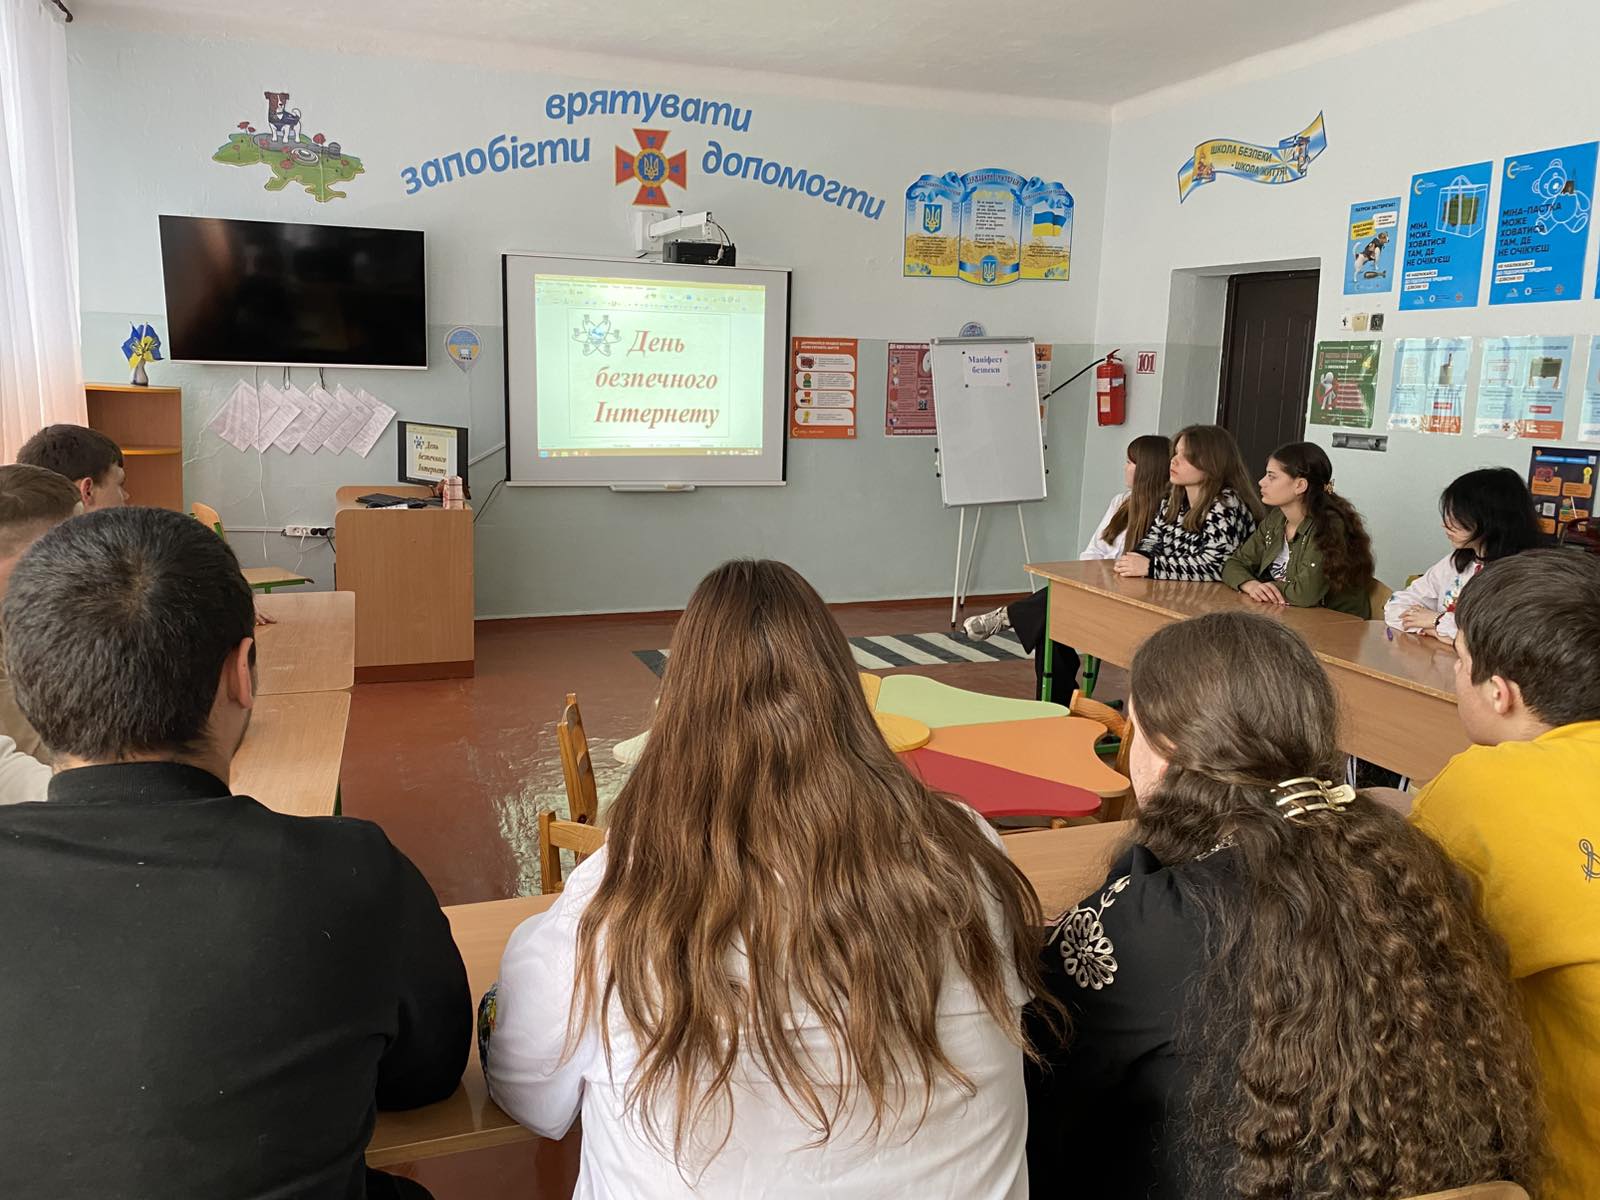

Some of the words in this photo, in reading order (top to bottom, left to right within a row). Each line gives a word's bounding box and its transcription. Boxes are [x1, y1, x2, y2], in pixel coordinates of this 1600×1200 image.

[545, 90, 753, 132] врятувати
[1210, 144, 1237, 155] ШКОЛА
[1238, 146, 1272, 163] БЕЗПЕКИ
[400, 135, 590, 194] запобігти
[1235, 162, 1260, 176] ШКОЛА
[702, 140, 885, 219] допомогти
[1502, 202, 1562, 217] МІНА-ПАСТКА
[1410, 222, 1428, 230] МІНА
[1502, 217, 1528, 227] МОЖЕ
[1410, 230, 1431, 239] МОЖЕ
[1519, 236, 1532, 245] ДЕ
[1408, 237, 1447, 248] ХОВАТИСЯ
[1498, 248, 1509, 256] НЕ
[1407, 259, 1415, 267] НЕ
[627, 330, 685, 357] День
[1138, 354, 1156, 372] 101
[595, 366, 718, 390] безпечного
[593, 401, 720, 429] Інтернету
